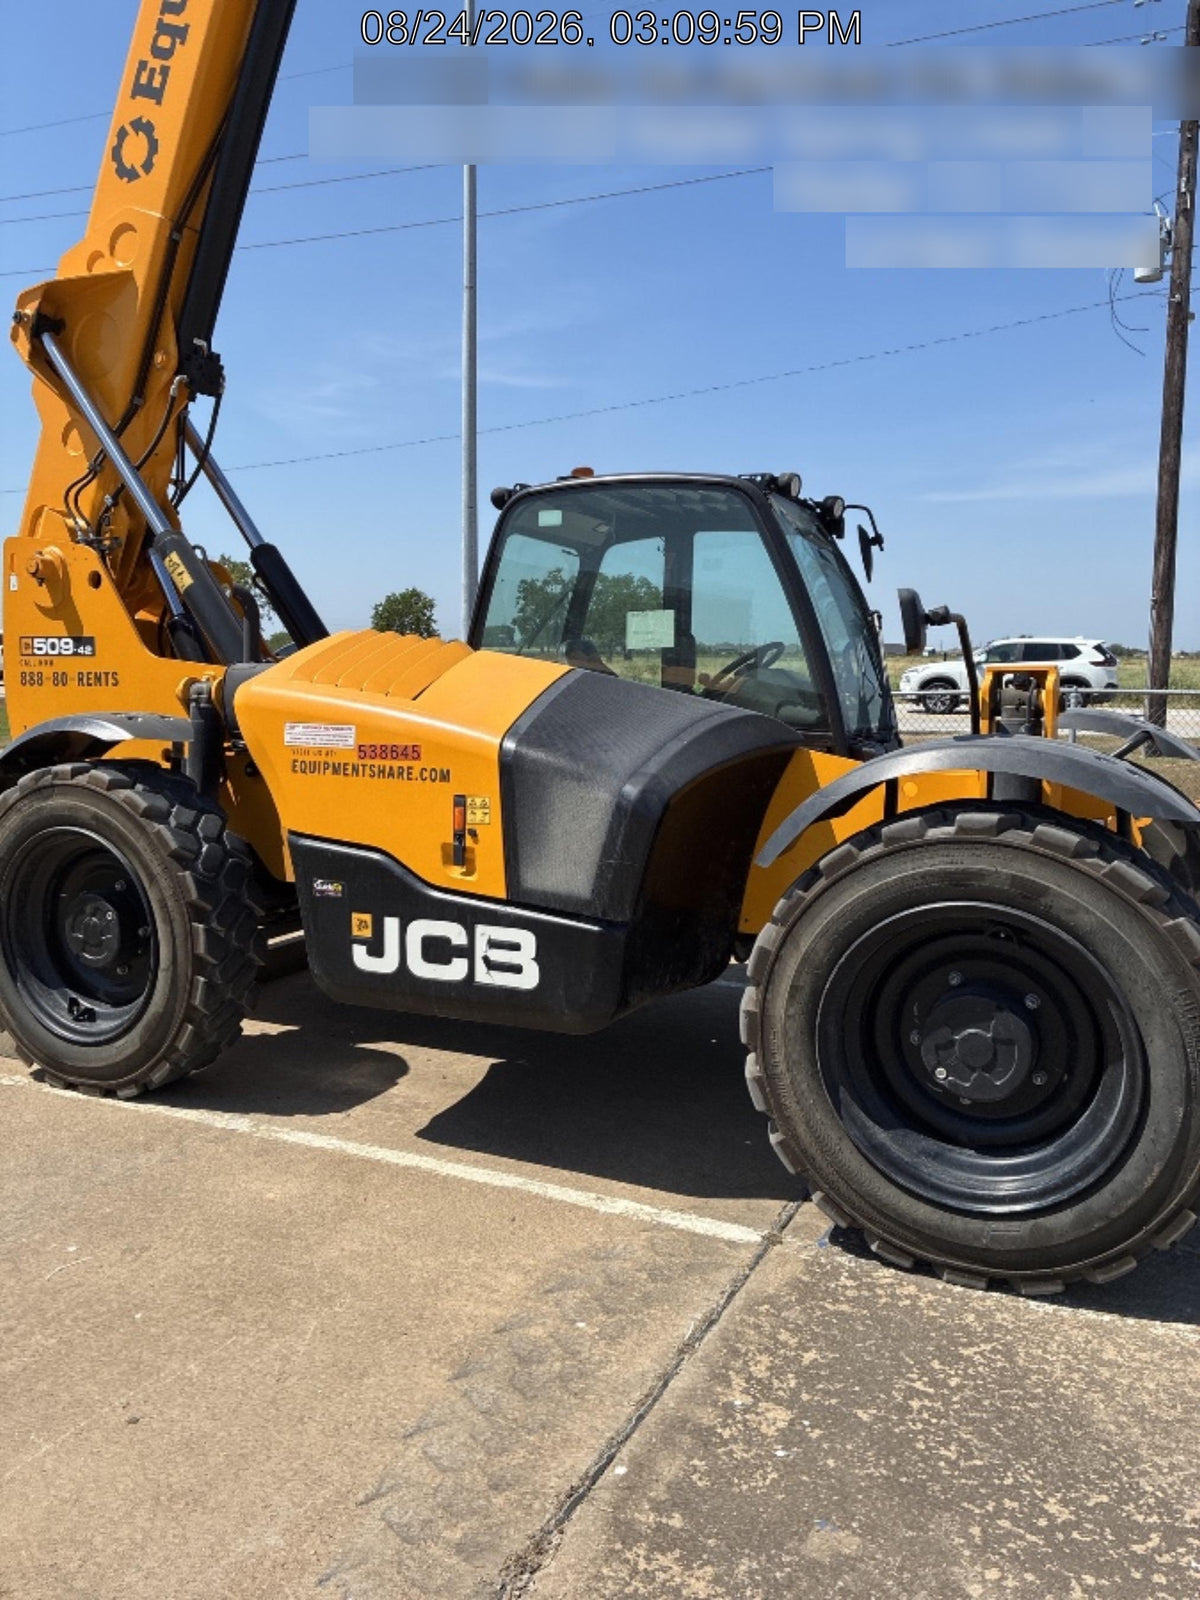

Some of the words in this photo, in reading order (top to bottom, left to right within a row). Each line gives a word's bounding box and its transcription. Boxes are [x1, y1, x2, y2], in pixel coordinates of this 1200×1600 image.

[358, 745, 421, 760] 538645
[291, 759, 451, 783] EQUIPMENTSHARE.COM
[351, 916, 540, 991] JCB
